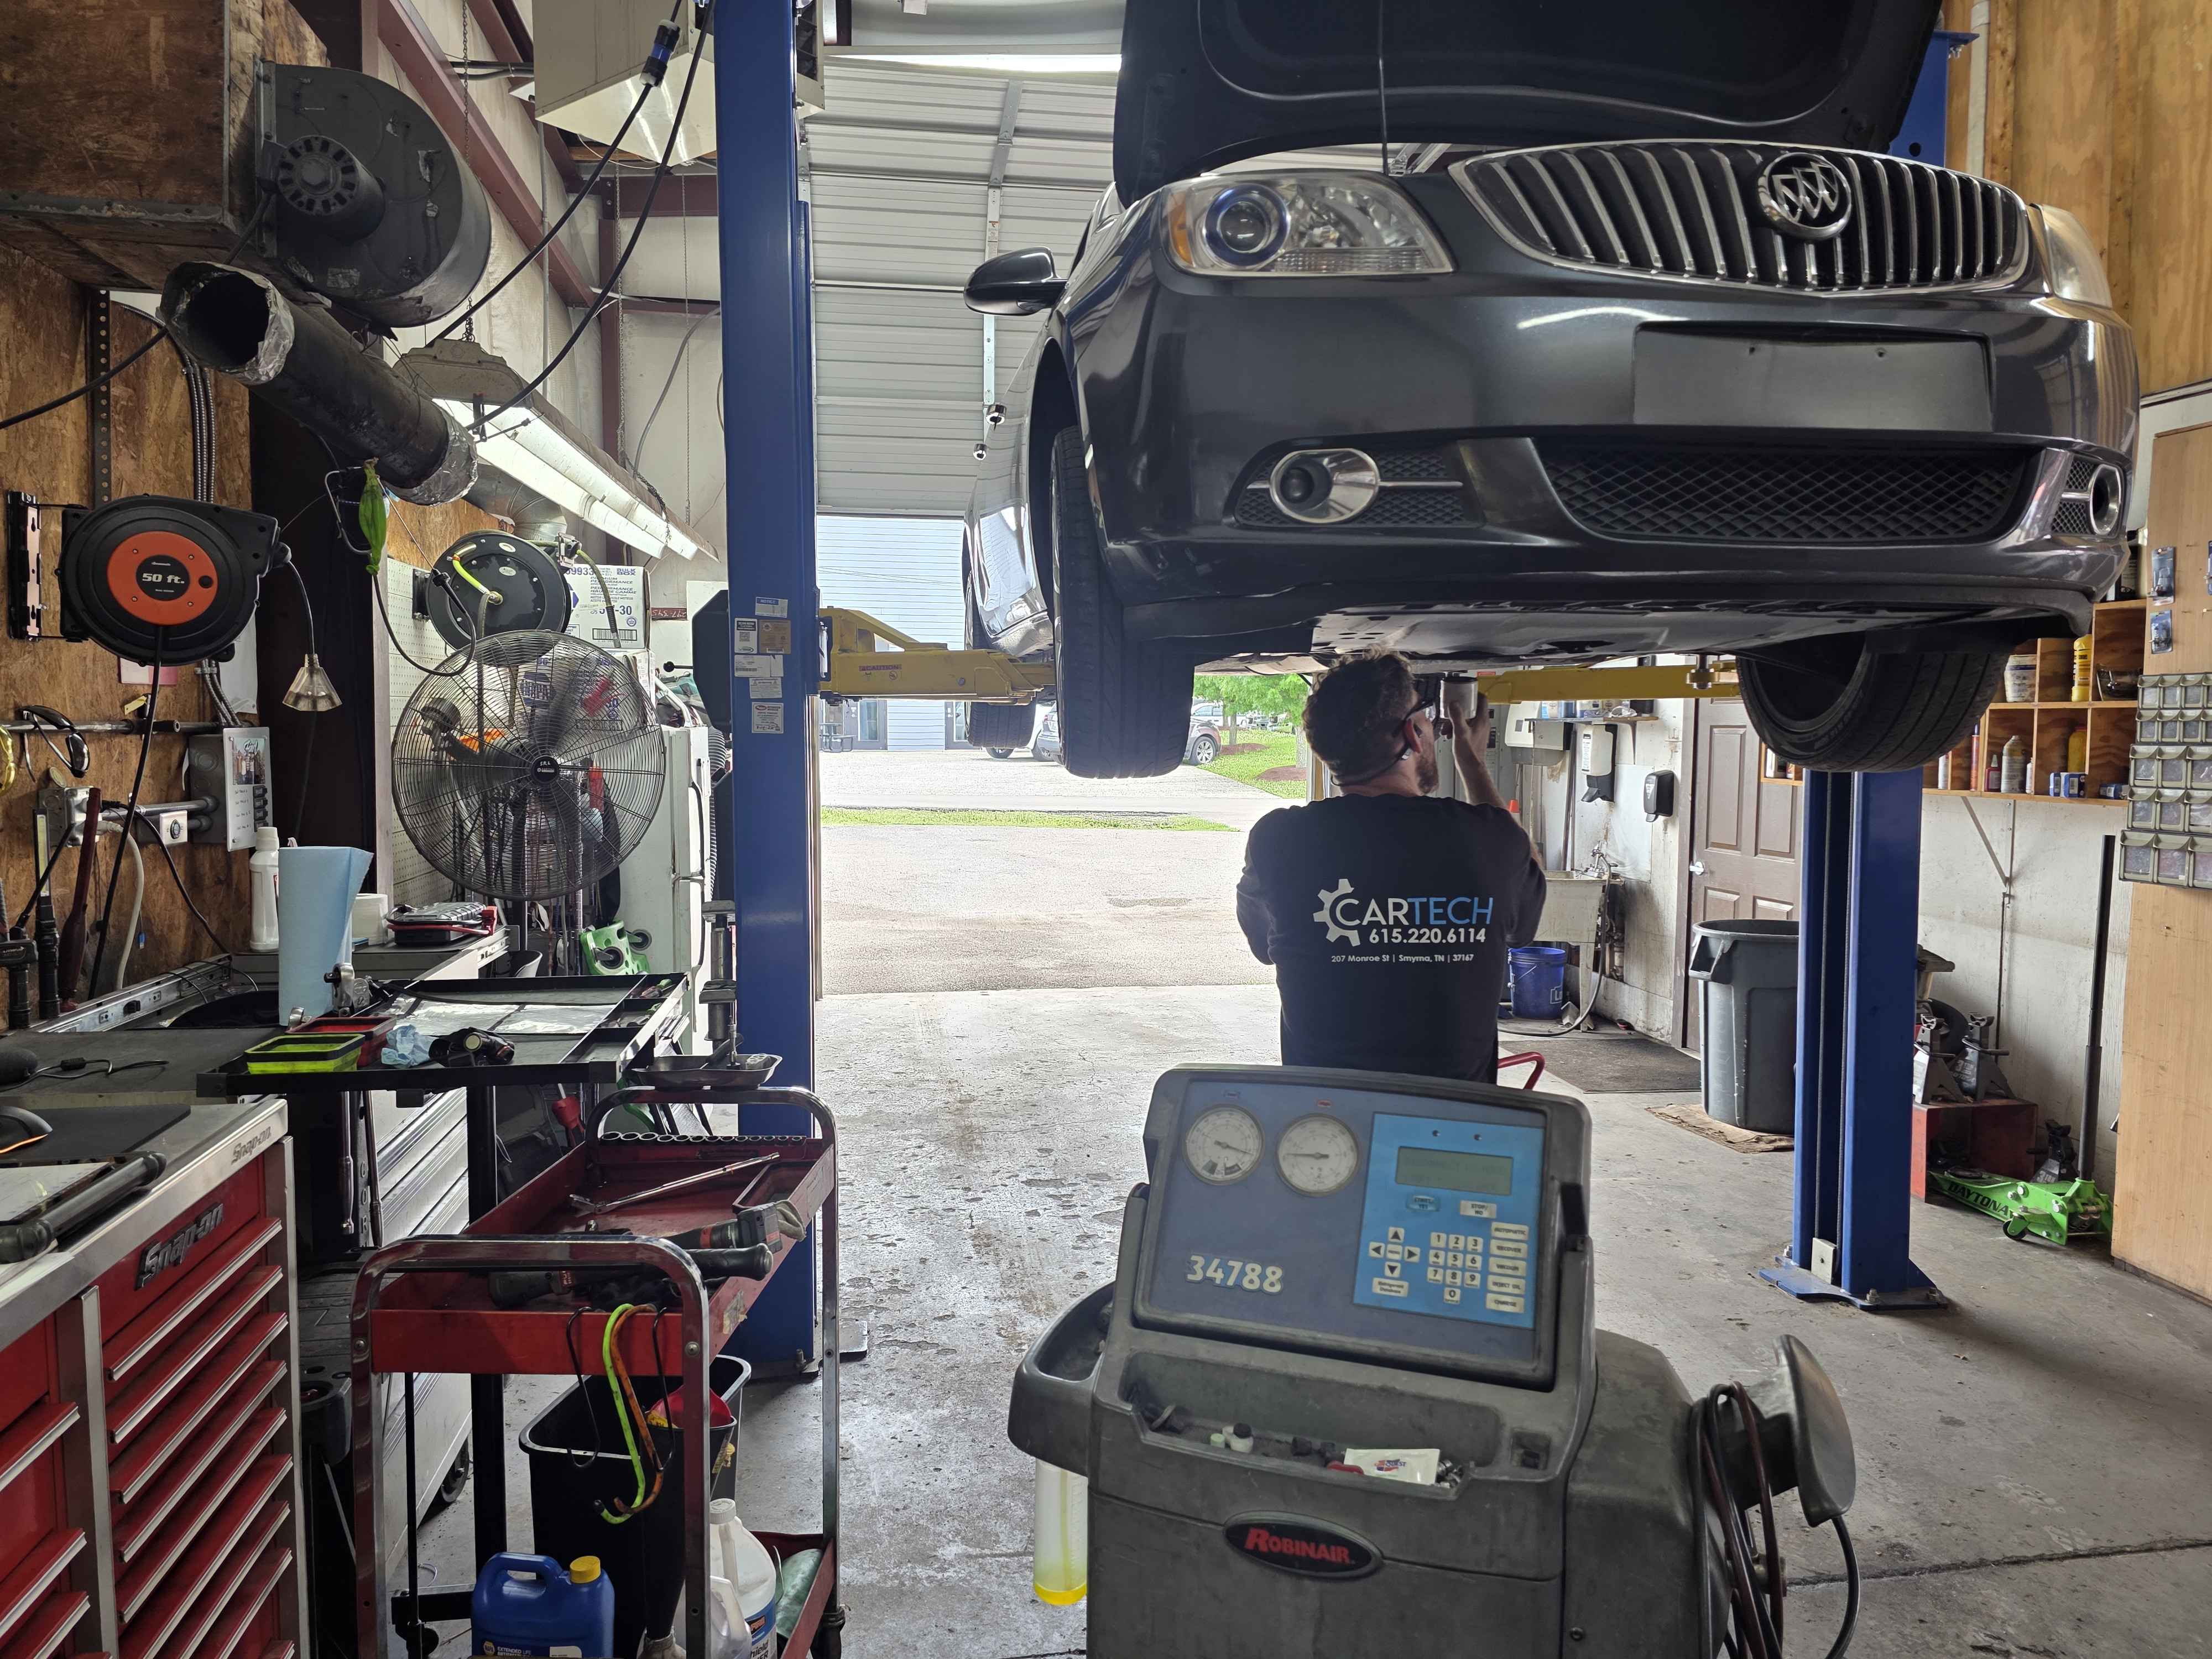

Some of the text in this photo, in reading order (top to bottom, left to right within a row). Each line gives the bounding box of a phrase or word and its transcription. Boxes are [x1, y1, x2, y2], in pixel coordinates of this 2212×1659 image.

[142, 573, 185, 584] 50 ft.
[1335, 896, 1493, 926] CARTECH
[1369, 927, 1486, 944] 615.220.6114
[231, 1126, 272, 1165] Snap-on
[1947, 1184, 2010, 1216] DAYTONA
[142, 1203, 223, 1287] Snap-on
[1436, 1234, 1478, 1247] 1 2 3
[1496, 1245, 1522, 1254] RECOVER
[1433, 1251, 1477, 1265] 4 5 6
[1187, 1255, 1283, 1293] 34788
[1496, 1263, 1519, 1271] VACUUM
[1433, 1269, 1438, 1277] 7
[1451, 1271, 1457, 1280] 8
[1449, 1289, 1456, 1298] 0
[1494, 1299, 1517, 1307] CHARGE
[1245, 1527, 1350, 1564] ROBINAIR
